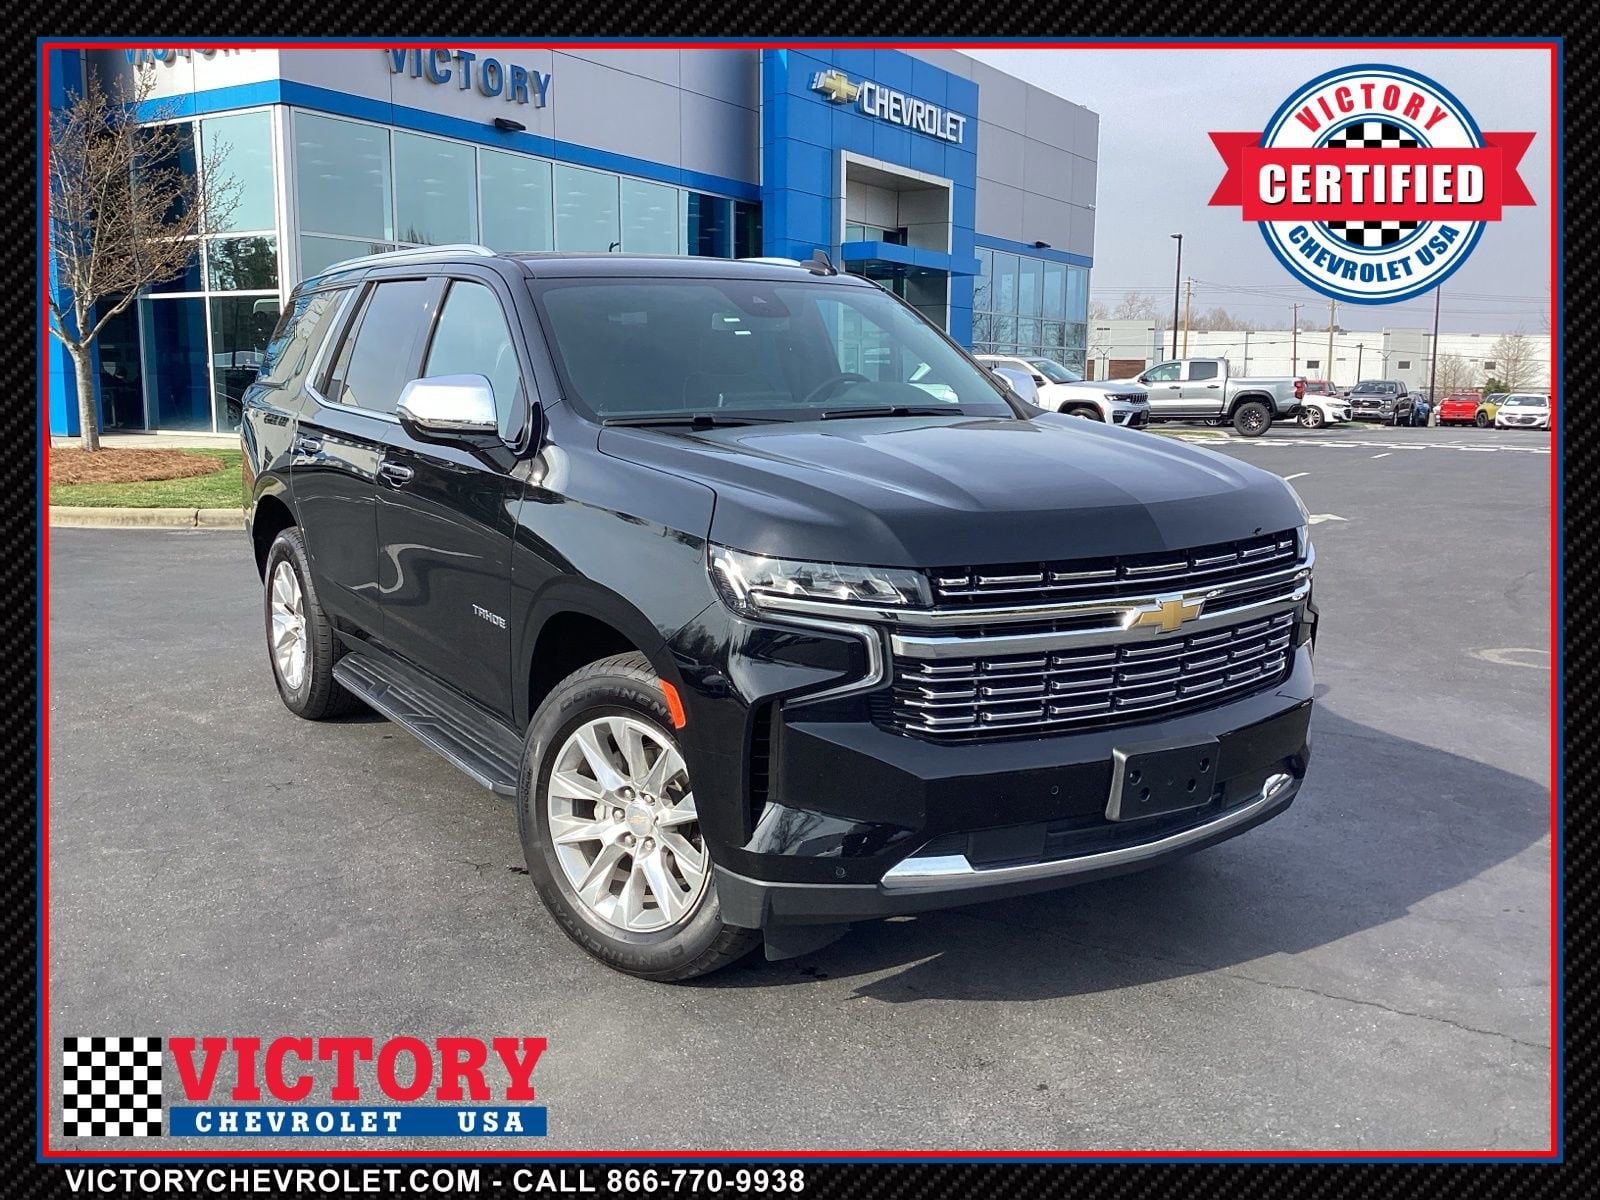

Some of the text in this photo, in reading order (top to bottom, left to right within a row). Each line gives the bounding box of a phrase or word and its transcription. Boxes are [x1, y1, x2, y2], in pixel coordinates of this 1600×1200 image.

[385, 48, 551, 108] VICTORY
[862, 81, 967, 144] CHEVROLET
[472, 603, 506, 629] TAHOE
